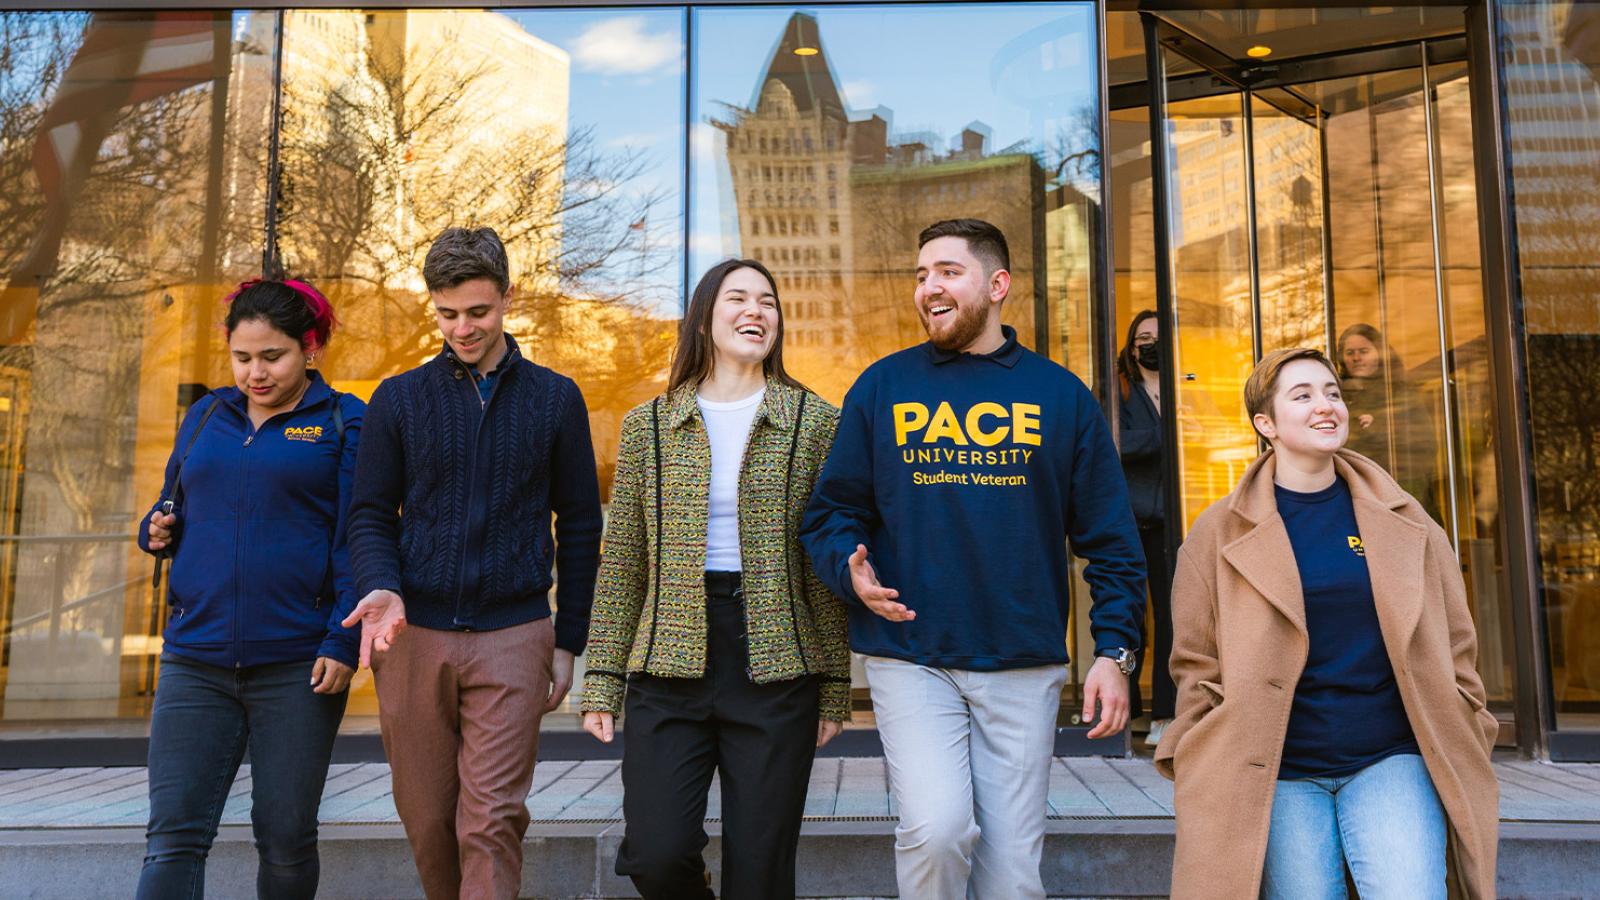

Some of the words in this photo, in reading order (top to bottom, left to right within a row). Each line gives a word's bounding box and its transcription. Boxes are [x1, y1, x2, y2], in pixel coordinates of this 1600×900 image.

[285, 426, 323, 437] PACE
[893, 401, 1041, 446] PACE
[903, 448, 1033, 465] UNIVERSITY
[913, 470, 968, 485] Student
[971, 473, 1026, 486] Veteran
